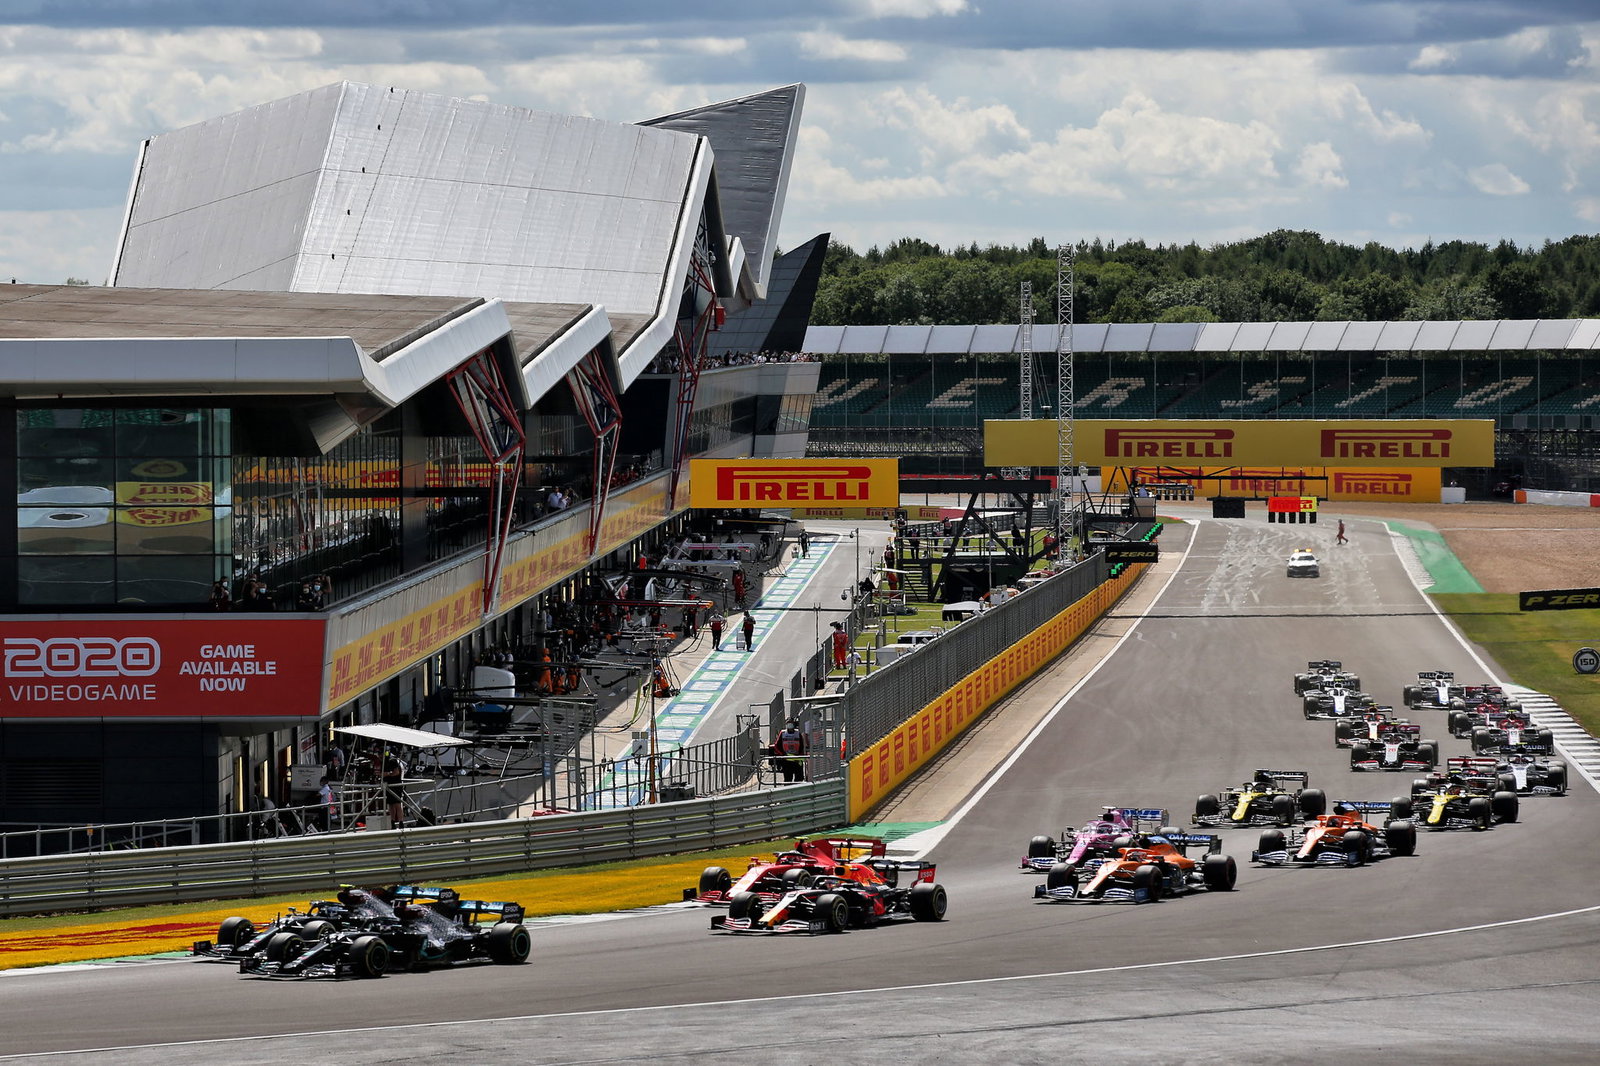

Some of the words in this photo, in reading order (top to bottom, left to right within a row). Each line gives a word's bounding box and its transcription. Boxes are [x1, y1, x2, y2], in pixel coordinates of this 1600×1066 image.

[1105, 429, 1235, 457] PIRELLI
[1321, 429, 1452, 458] PIRELLI
[717, 467, 871, 500] PIRELLI
[1334, 472, 1412, 495] PIRELLI
[1525, 596, 1545, 606] P
[1548, 594, 1600, 605] ZER
[4, 637, 161, 677] 2020
[200, 645, 255, 659] GAME
[179, 661, 276, 675] AVAILABLE
[1580, 658, 1595, 666] 150
[200, 678, 246, 691] NOW
[9, 685, 156, 701] VIDEOGAME
